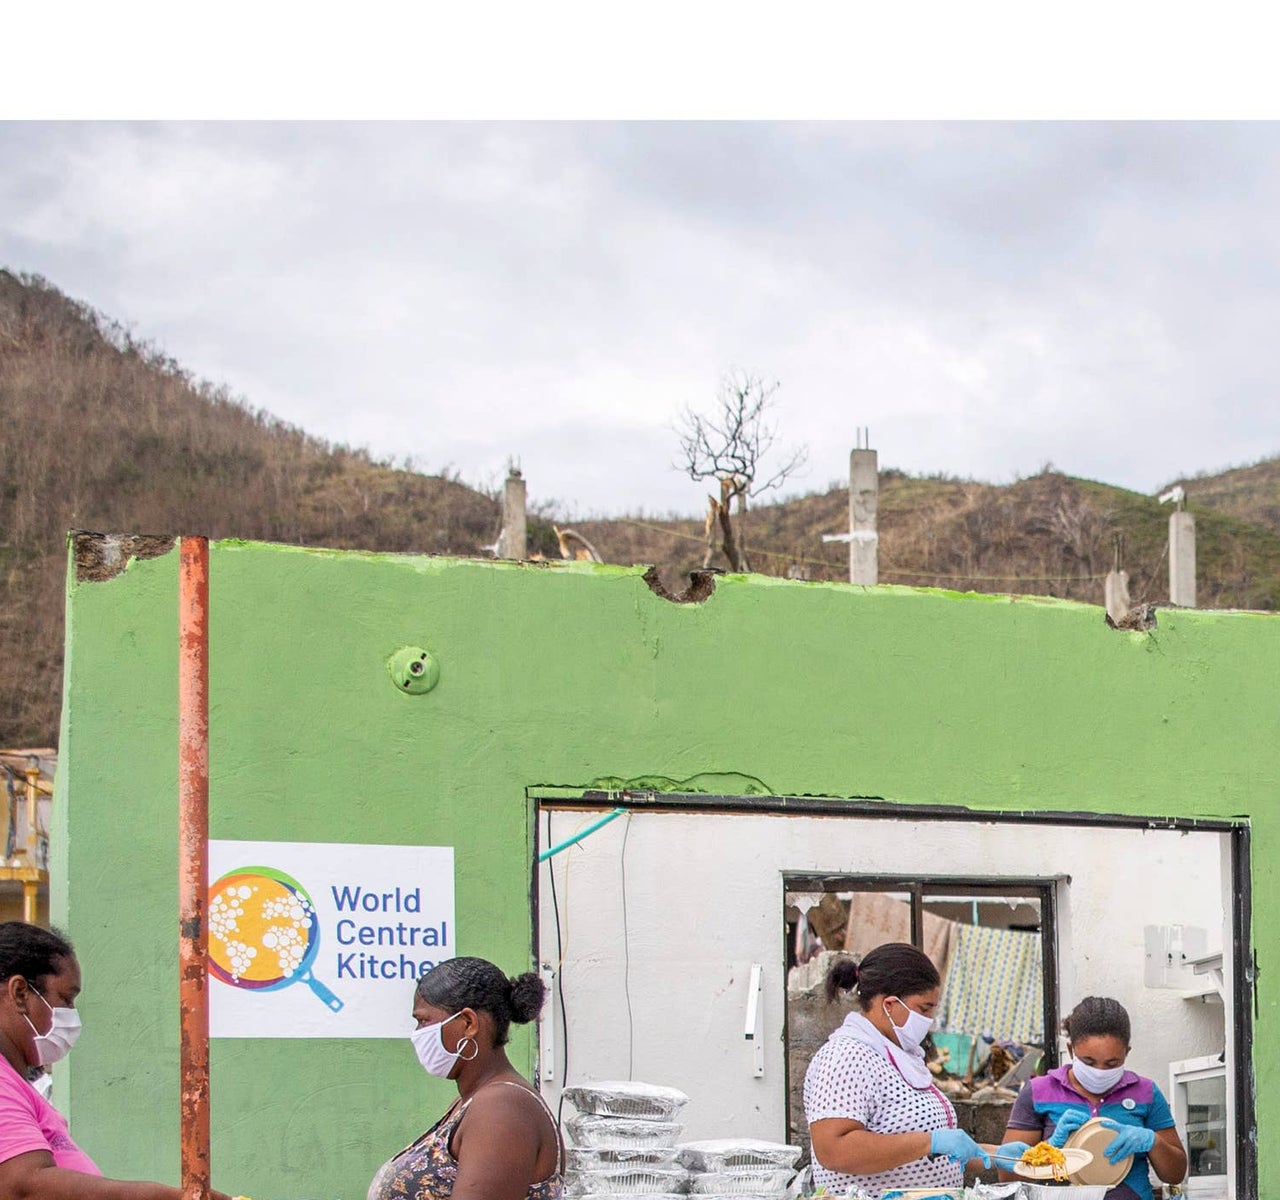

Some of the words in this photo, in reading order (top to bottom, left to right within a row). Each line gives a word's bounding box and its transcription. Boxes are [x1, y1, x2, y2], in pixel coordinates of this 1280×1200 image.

[331, 886, 421, 913] World
[336, 920, 448, 947] Central
[337, 953, 442, 980] Kitche
